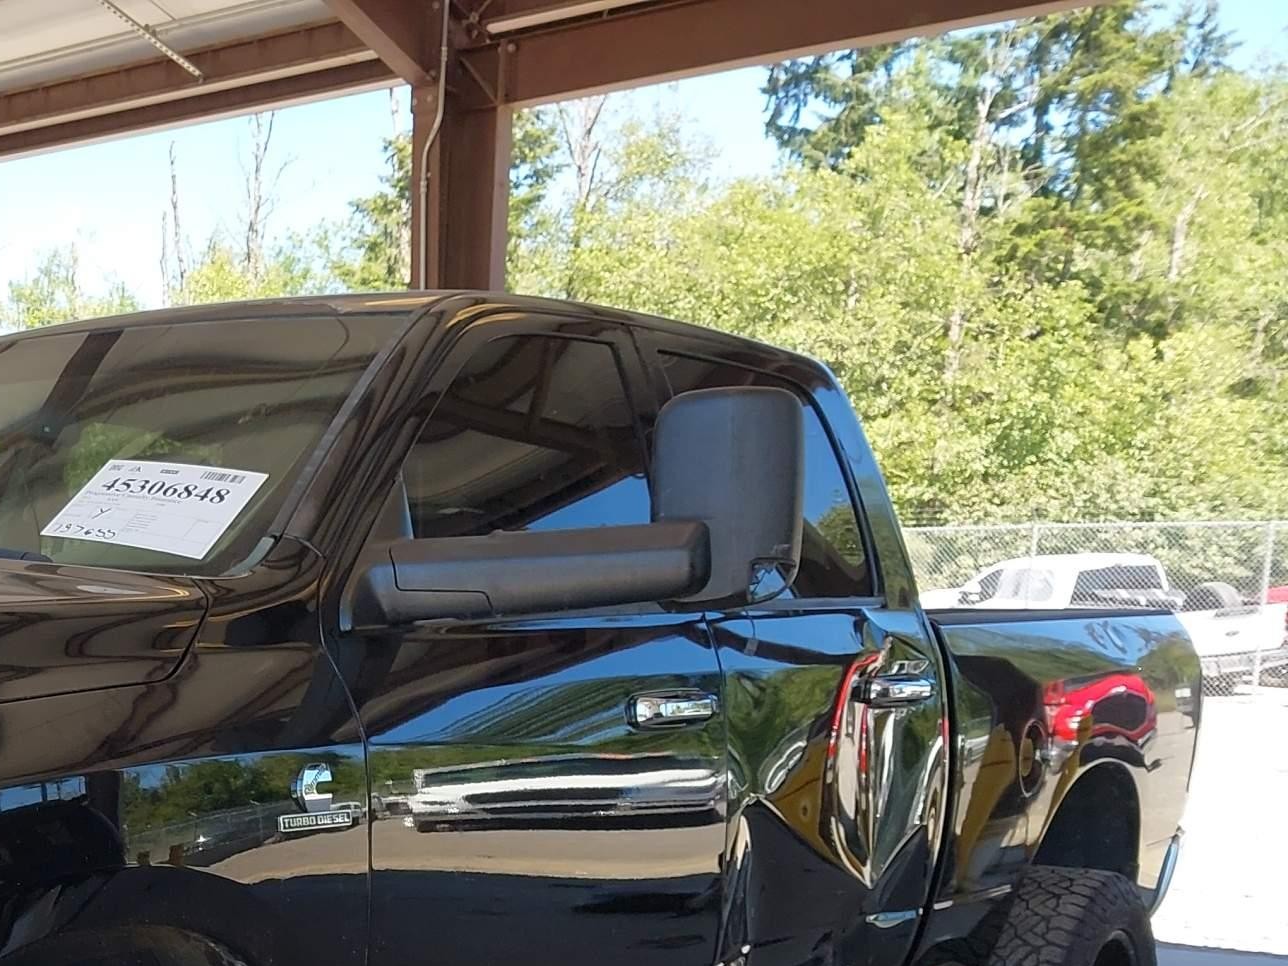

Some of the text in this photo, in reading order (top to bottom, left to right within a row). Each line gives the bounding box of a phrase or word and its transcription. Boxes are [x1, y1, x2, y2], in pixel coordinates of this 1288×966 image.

[102, 477, 230, 504] 45306848
[284, 813, 350, 828] TURBO DIESEL
